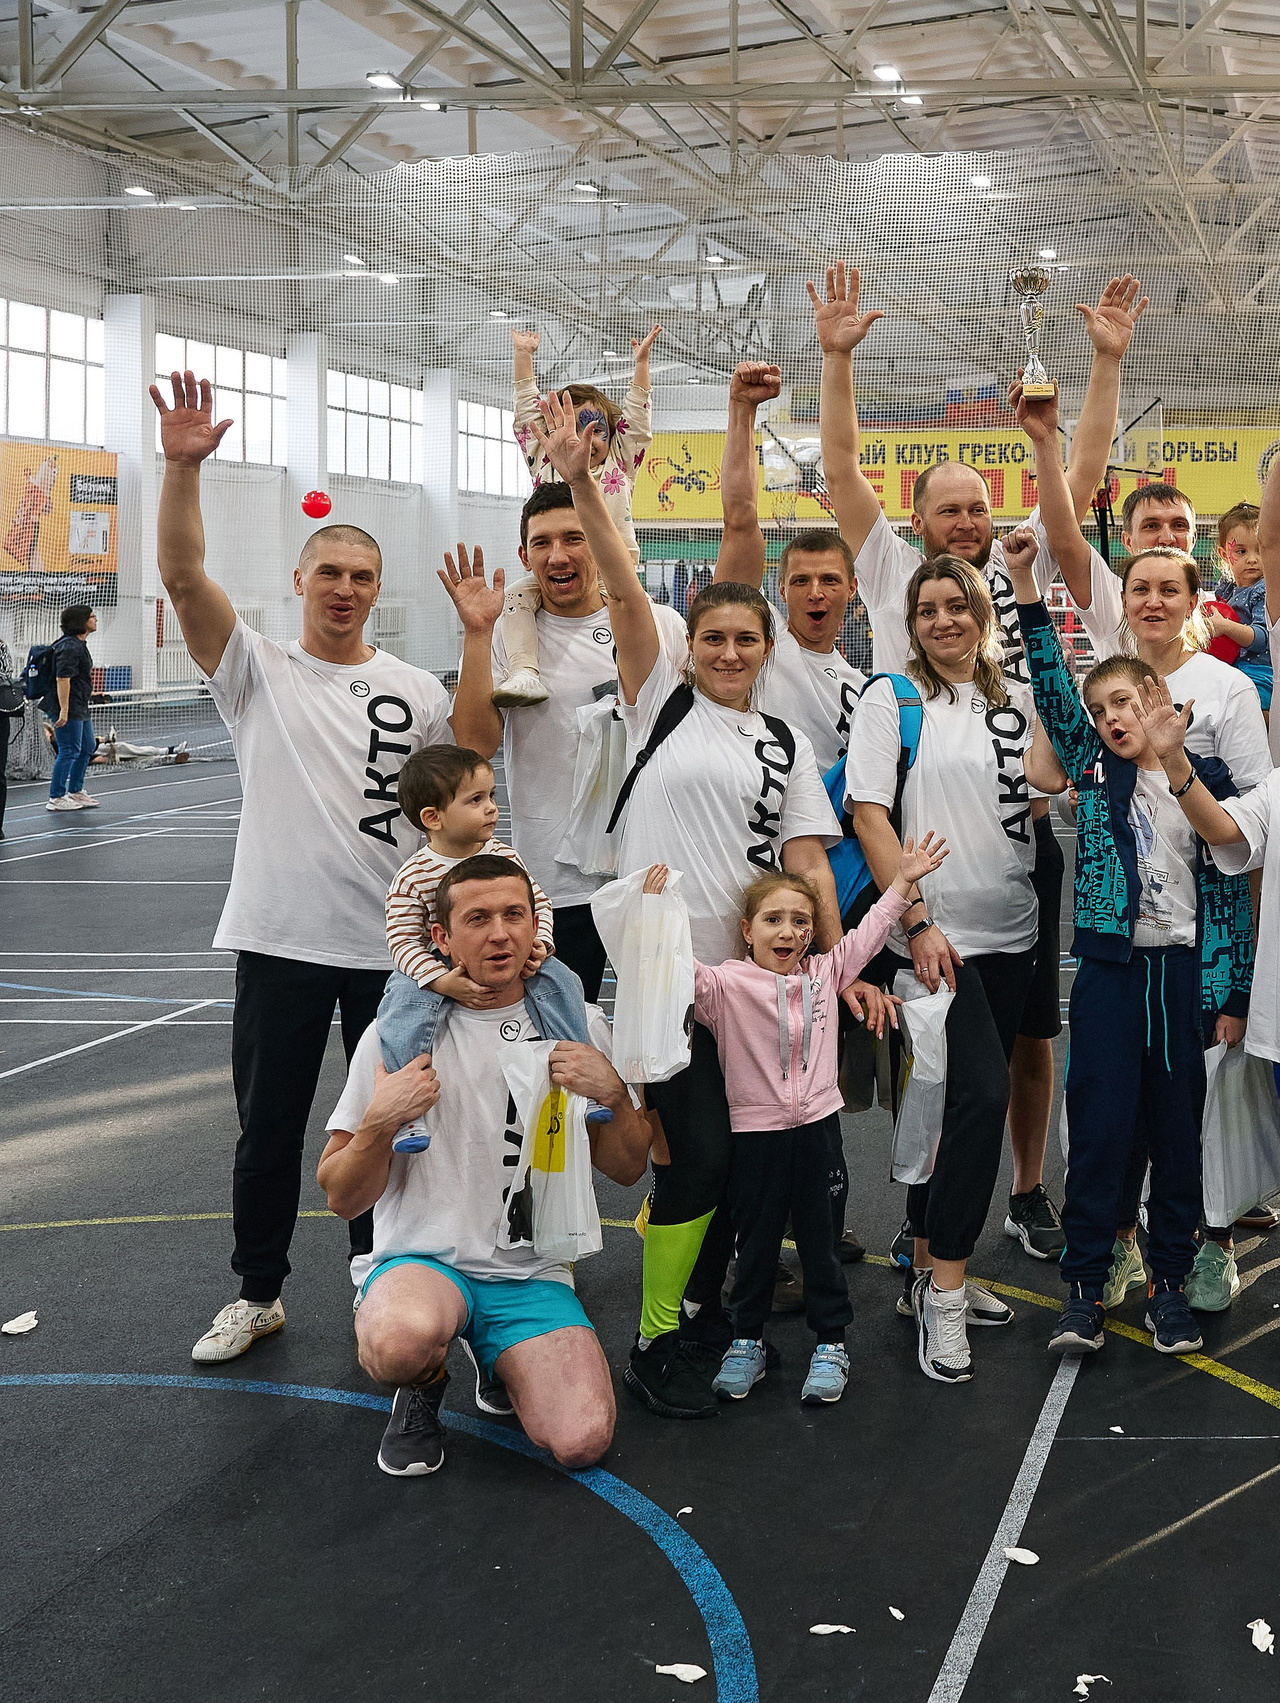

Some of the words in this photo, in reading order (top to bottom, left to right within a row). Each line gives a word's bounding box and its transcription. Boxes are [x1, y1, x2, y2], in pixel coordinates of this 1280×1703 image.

[896, 443, 949, 465] КЛУБ
[1147, 440, 1238, 463] БОРЬБЫ
[359, 695, 414, 848] АКТО
[747, 739, 789, 873] АКТО
[985, 707, 1030, 845] АКТО
